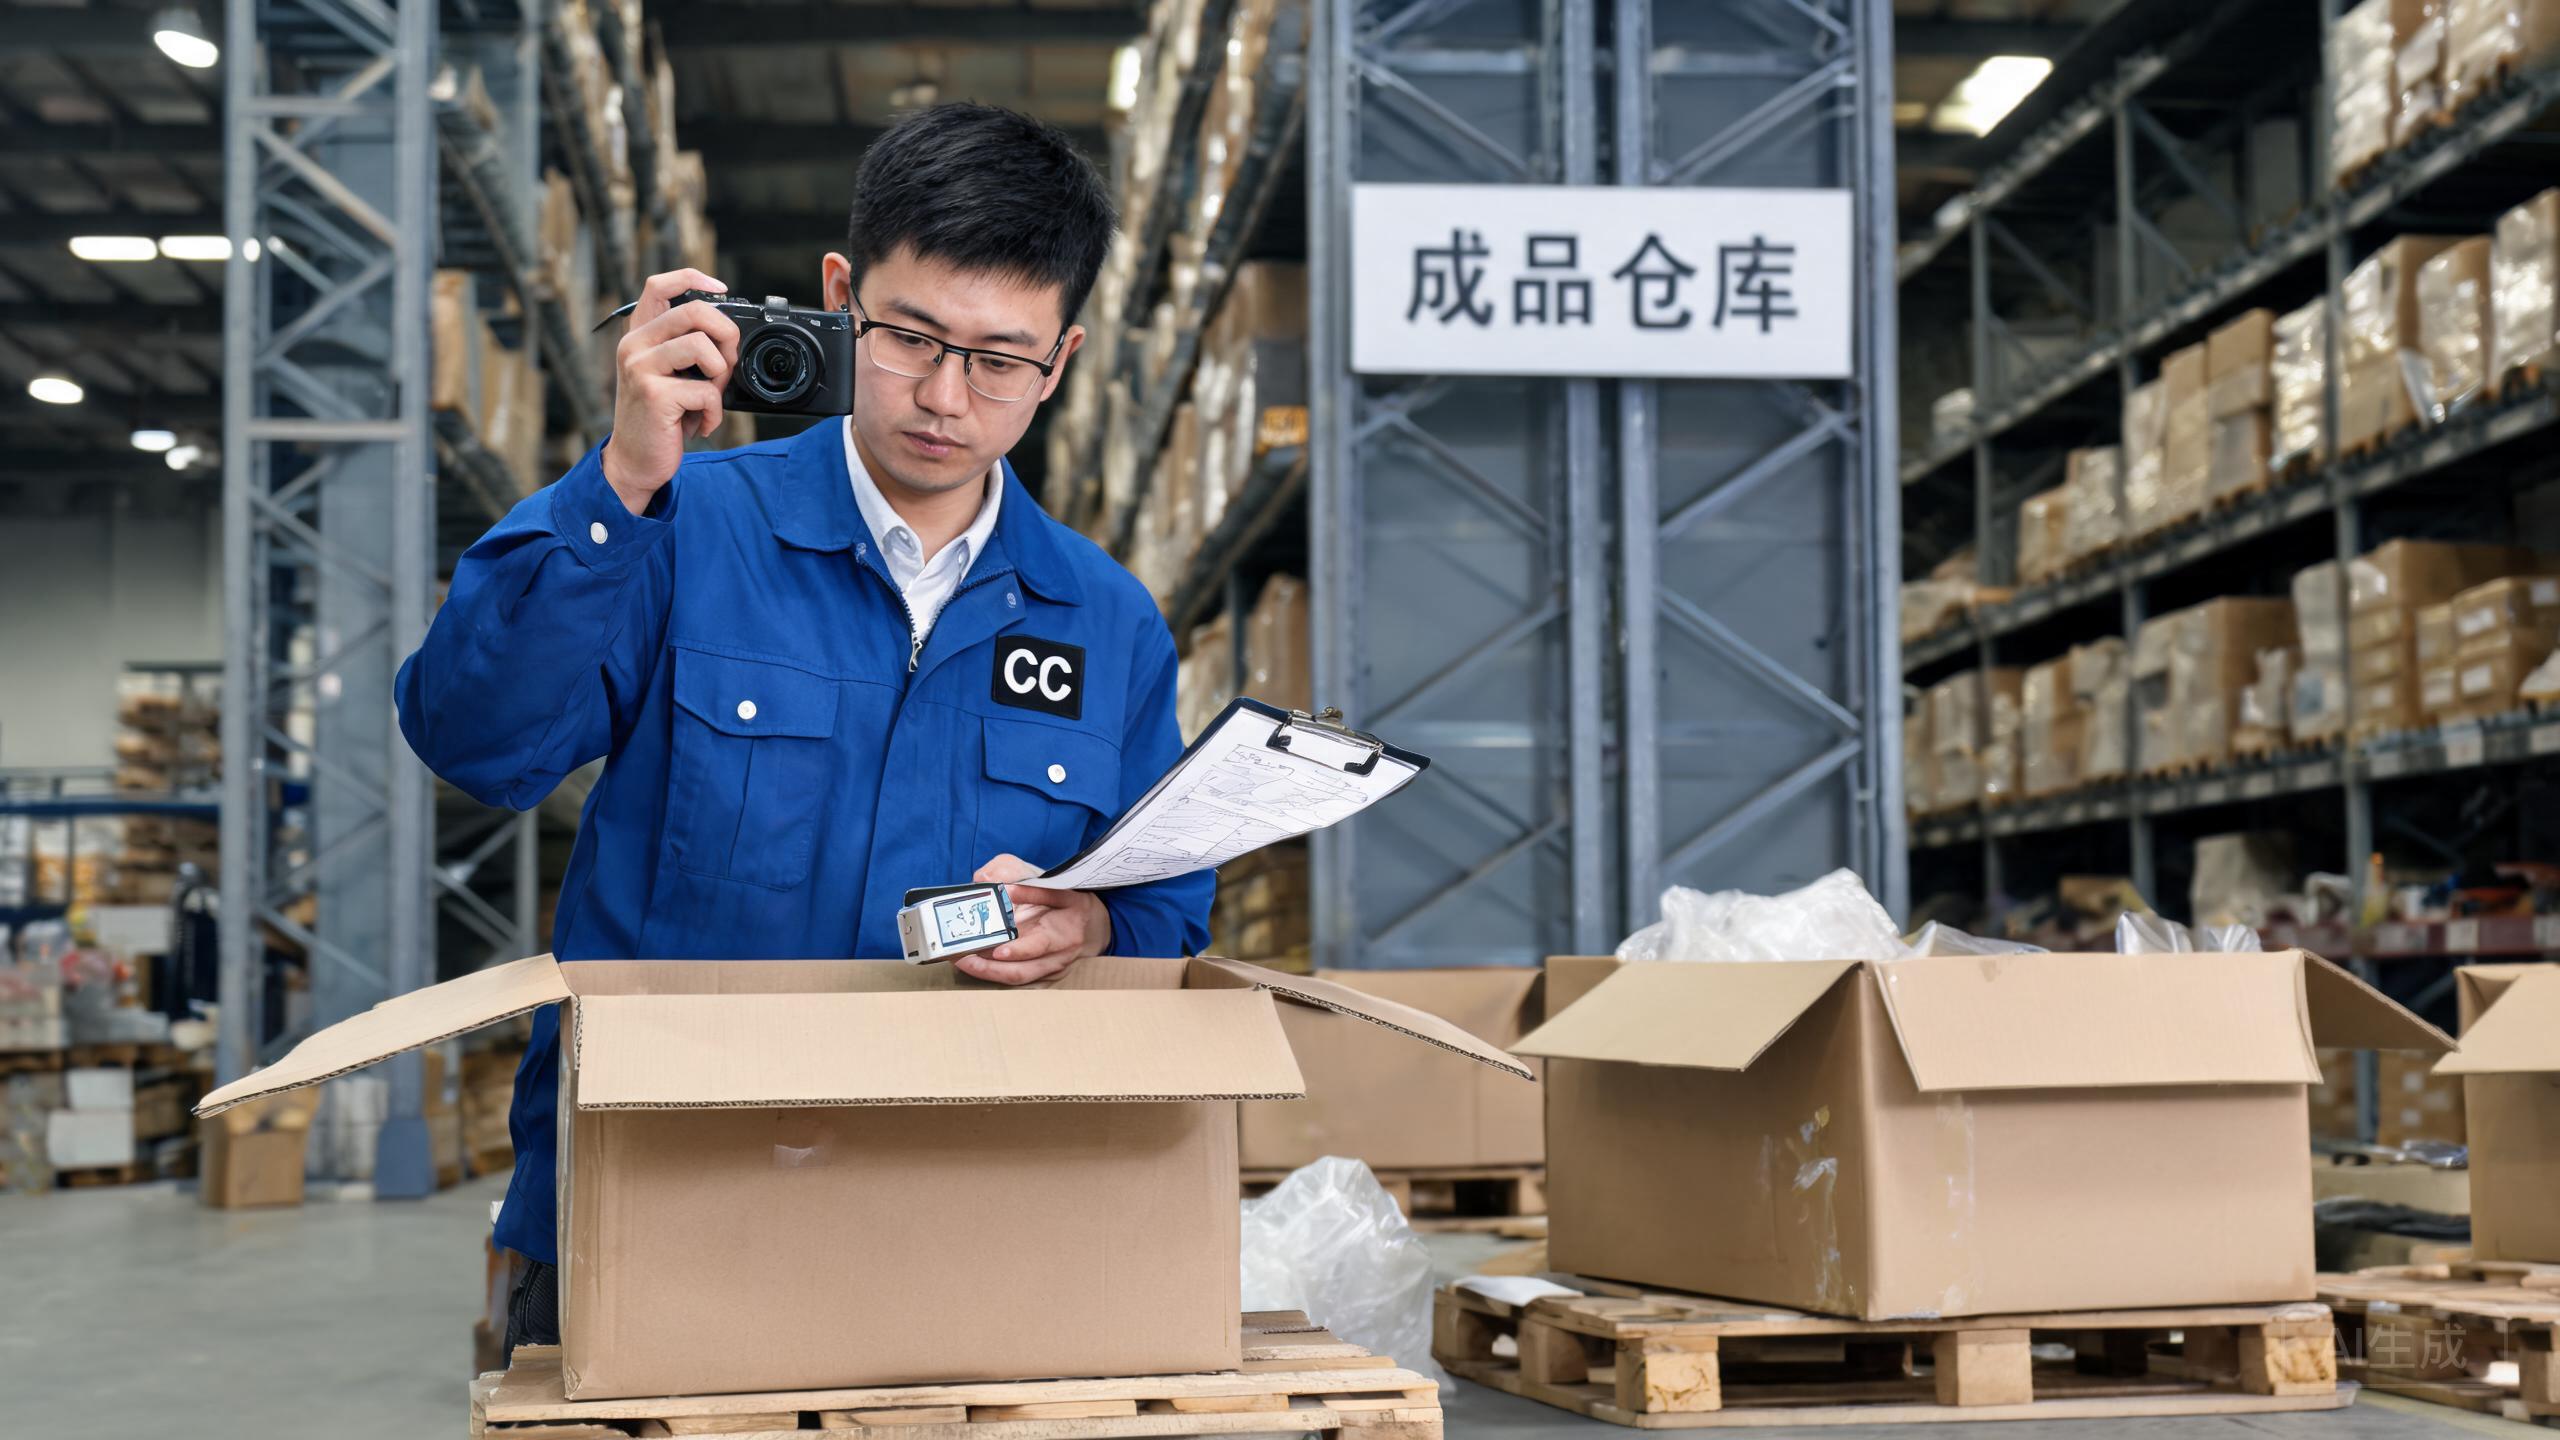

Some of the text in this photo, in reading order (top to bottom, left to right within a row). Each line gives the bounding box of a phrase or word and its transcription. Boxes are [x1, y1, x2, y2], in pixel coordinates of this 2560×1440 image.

[1406, 229, 1798, 333] 成品仓库
[1004, 648, 1073, 702] CC
